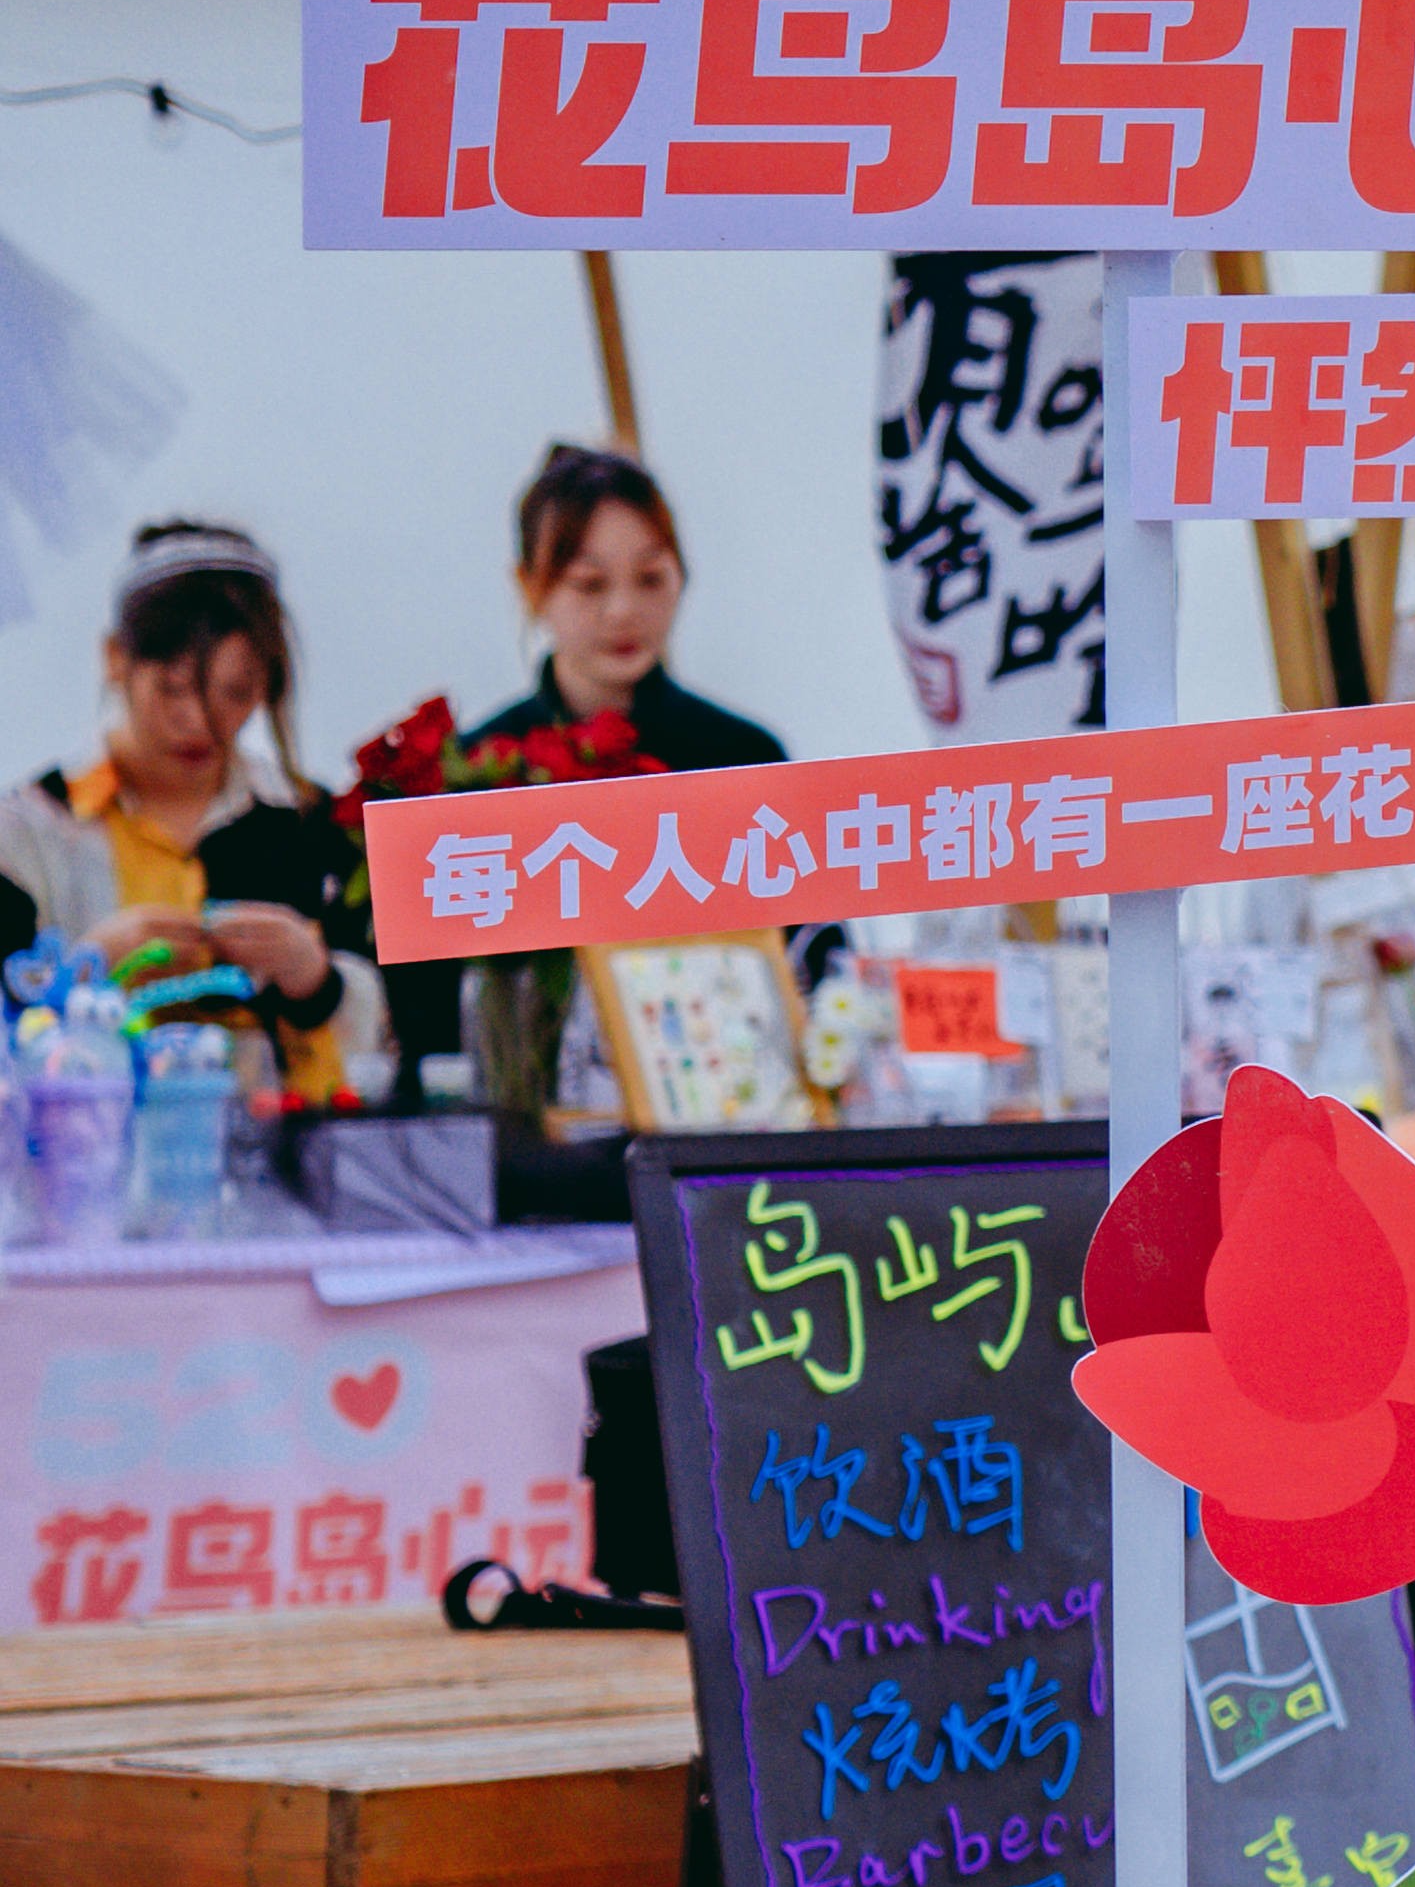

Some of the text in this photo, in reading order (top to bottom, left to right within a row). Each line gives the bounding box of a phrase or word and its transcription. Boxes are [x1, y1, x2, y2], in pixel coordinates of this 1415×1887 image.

[715, 1178, 1090, 1394] 岛屿
[32, 1329, 433, 1486] 520
[751, 1415, 1024, 1552] 饮酒
[753, 1575, 1104, 1716] Drinking
[803, 1657, 1082, 1819] 烧烤
